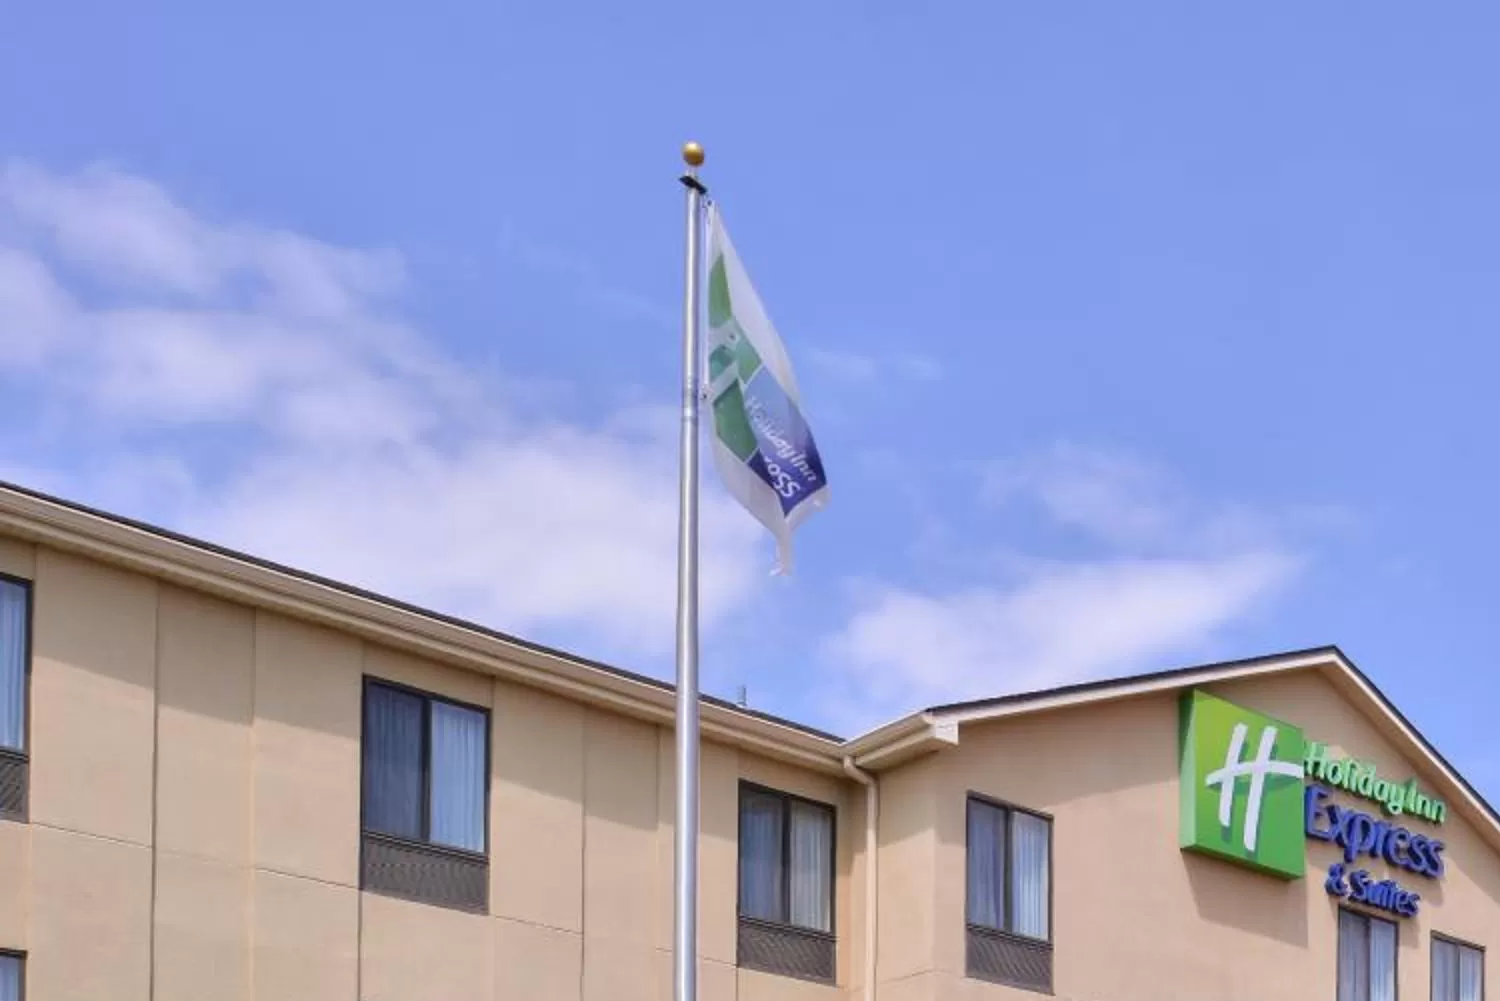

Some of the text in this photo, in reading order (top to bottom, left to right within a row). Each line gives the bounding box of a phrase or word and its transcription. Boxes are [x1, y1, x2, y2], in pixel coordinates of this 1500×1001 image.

[1304, 784, 1446, 879] Express
[1325, 862, 1421, 918] & Suites
